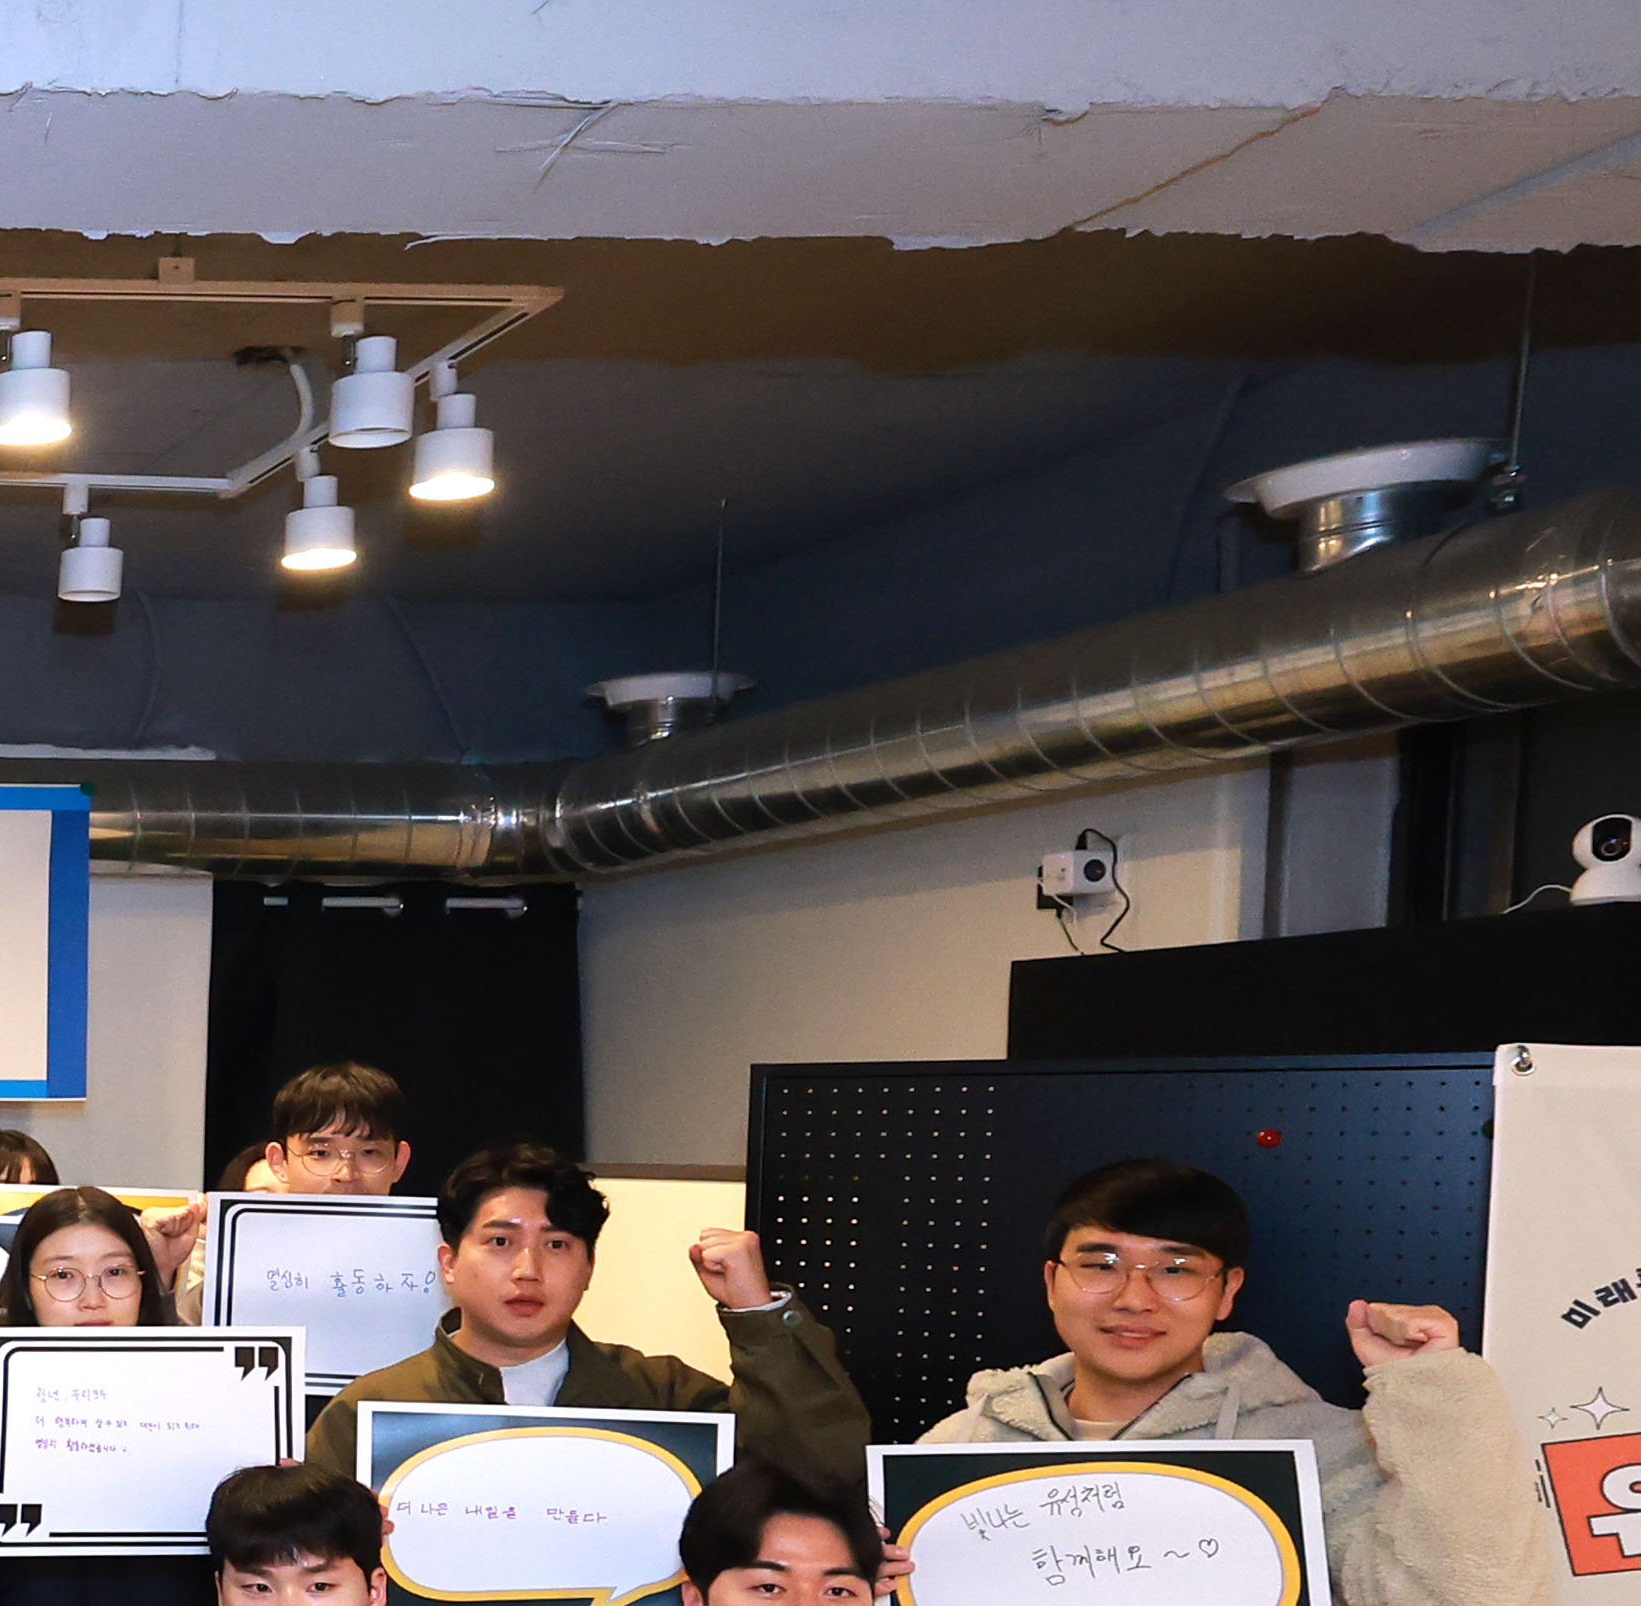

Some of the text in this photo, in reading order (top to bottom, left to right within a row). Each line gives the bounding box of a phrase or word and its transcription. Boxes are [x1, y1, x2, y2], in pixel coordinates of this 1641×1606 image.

[1560, 1268, 1641, 1330] 미래
[960, 1481, 1125, 1542] 빛나는 유성처럼
